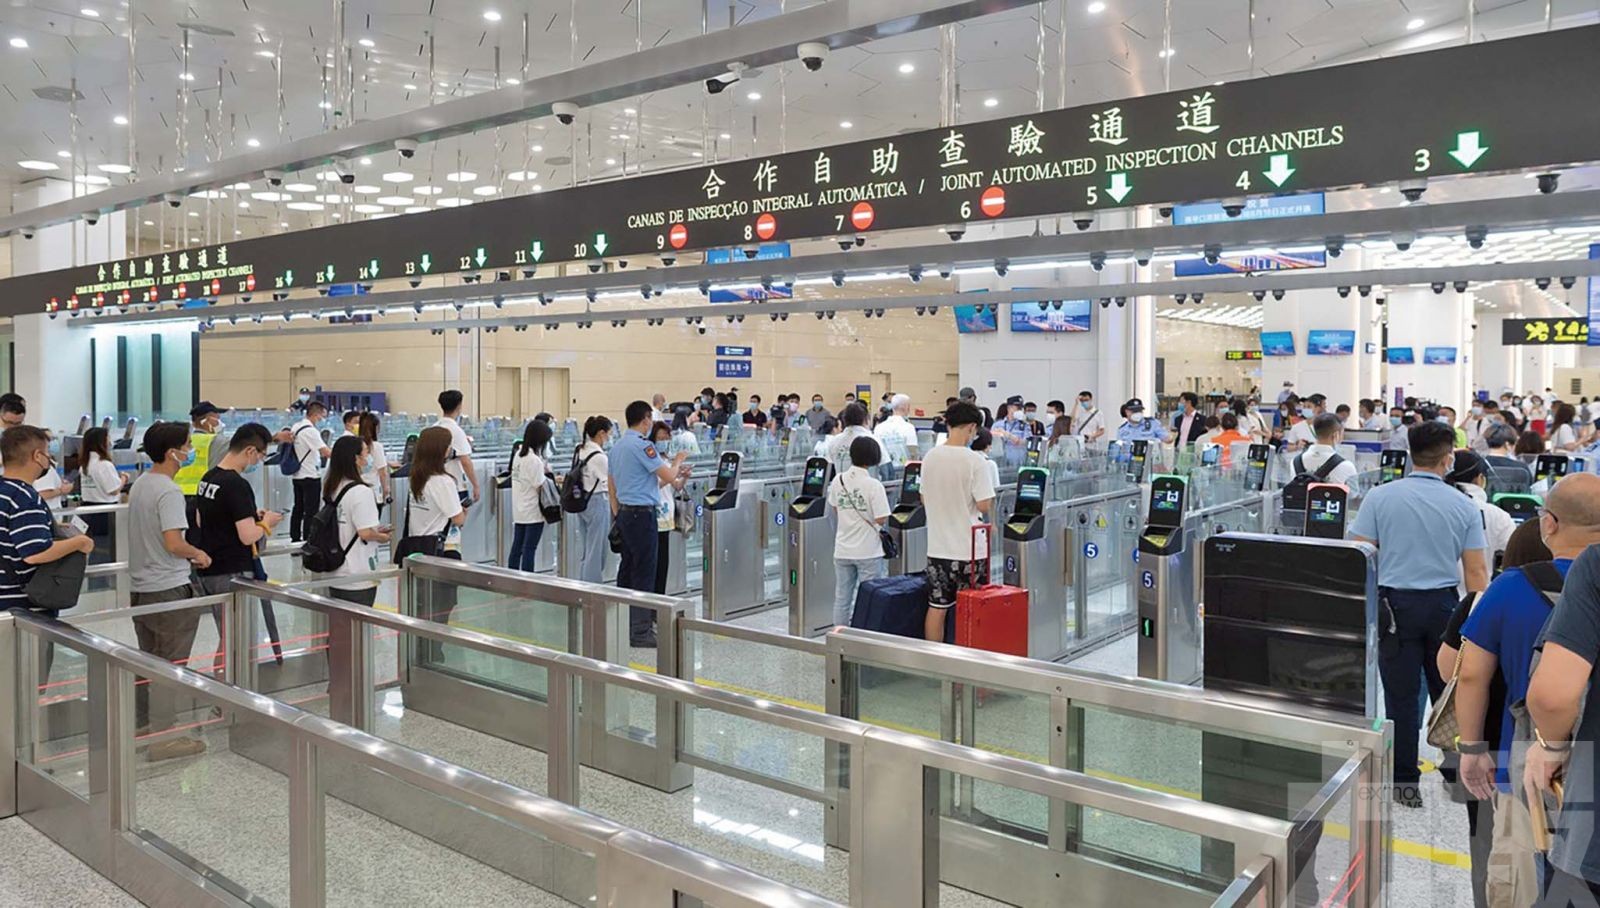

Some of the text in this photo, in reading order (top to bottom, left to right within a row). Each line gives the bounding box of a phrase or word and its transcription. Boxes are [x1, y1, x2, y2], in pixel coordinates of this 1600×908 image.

[703, 92, 1219, 199] 合作自助查驗通道
[1414, 149, 1431, 171] 3
[628, 125, 1344, 228] CANAIS DE INSPECÇÃO INTEGRAL AUTOMÁTICA / JOINT AUTOMATED INSPECTION CHANNELS
[1236, 171, 1250, 190] 4
[1086, 186, 1098, 206] 5
[961, 201, 972, 219] 6
[834, 214, 844, 231] 7
[744, 225, 753, 241] 8
[657, 234, 665, 249] 9
[515, 250, 527, 263] 11
[574, 243, 587, 258] 10
[406, 261, 416, 275] 13
[460, 256, 471, 270] 12
[316, 271, 325, 283] 15
[359, 267, 369, 280] 14
[696, 505, 703, 516] 9
[776, 513, 783, 525] 8
[1086, 544, 1096, 557] 5
[1007, 557, 1013, 570] 6
[1144, 572, 1152, 588] 5
